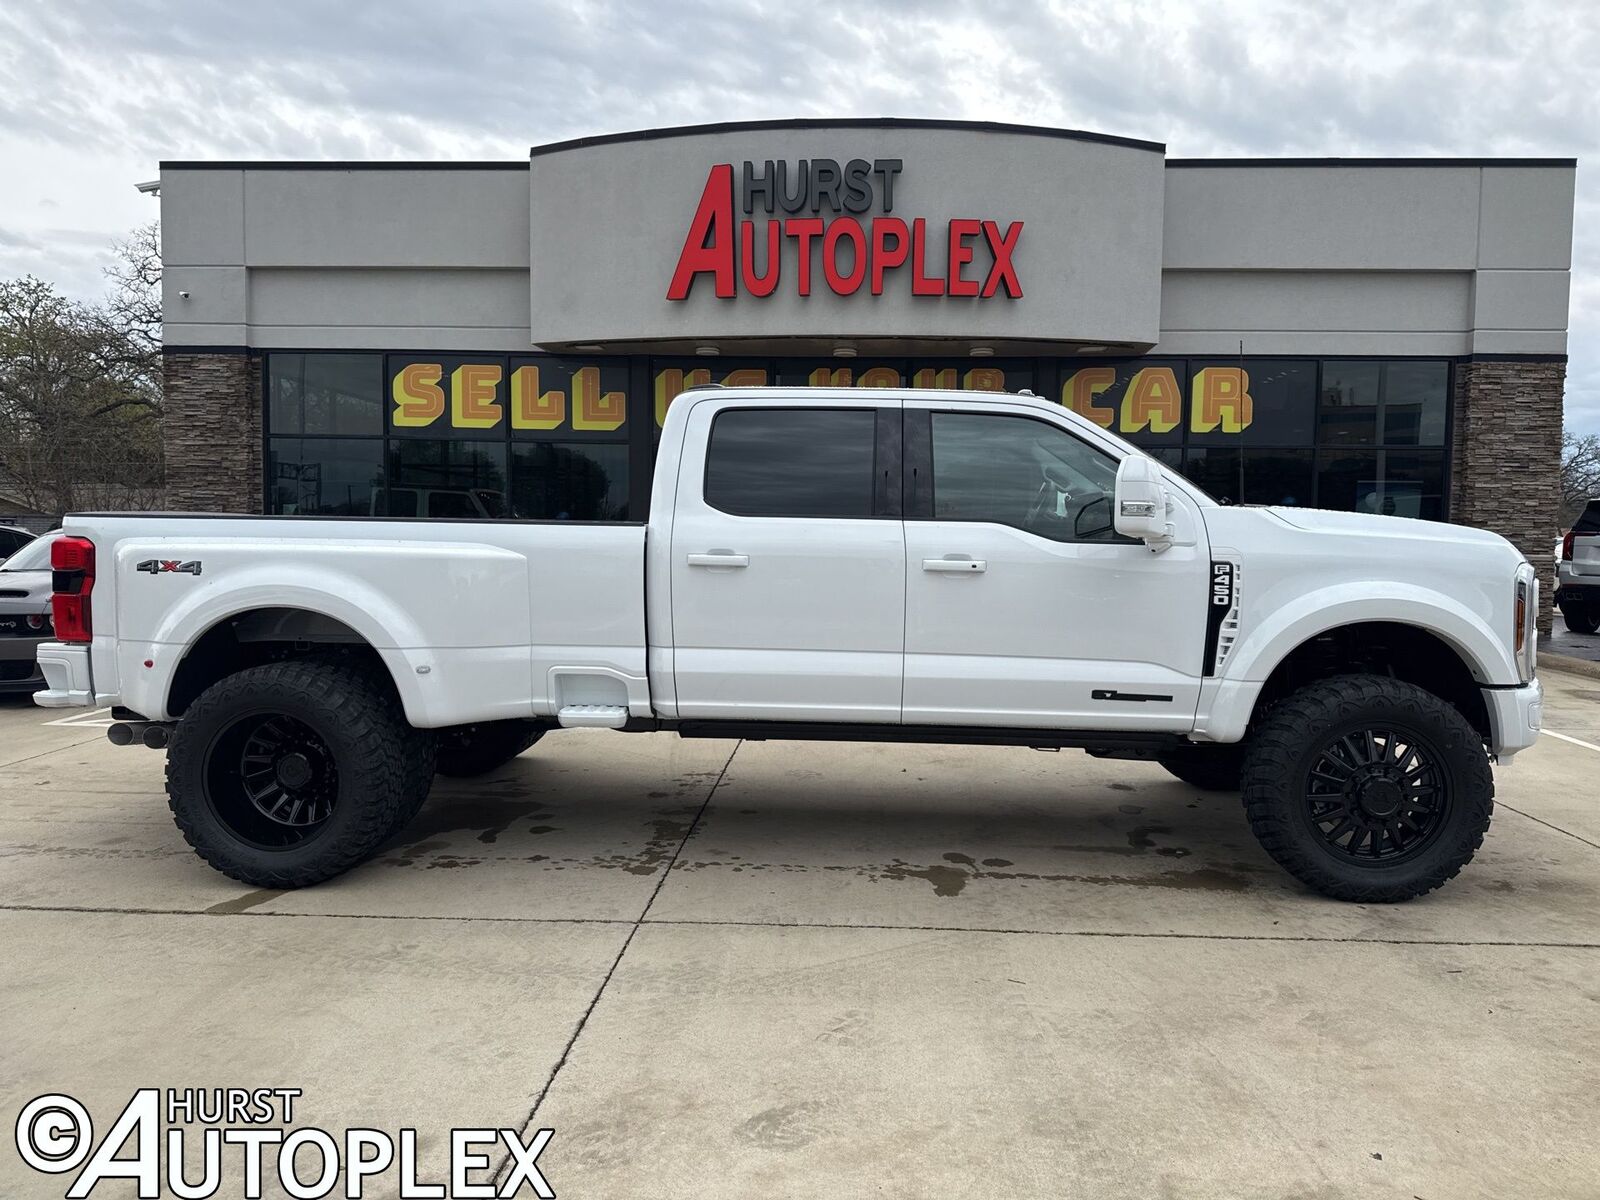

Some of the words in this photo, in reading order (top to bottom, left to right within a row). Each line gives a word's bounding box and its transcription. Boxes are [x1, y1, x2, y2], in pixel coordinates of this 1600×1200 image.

[743, 159, 903, 214] HURST
[666, 164, 1024, 300] AUTOPLEX
[393, 363, 626, 431] SELL
[1062, 367, 1253, 433] CAR
